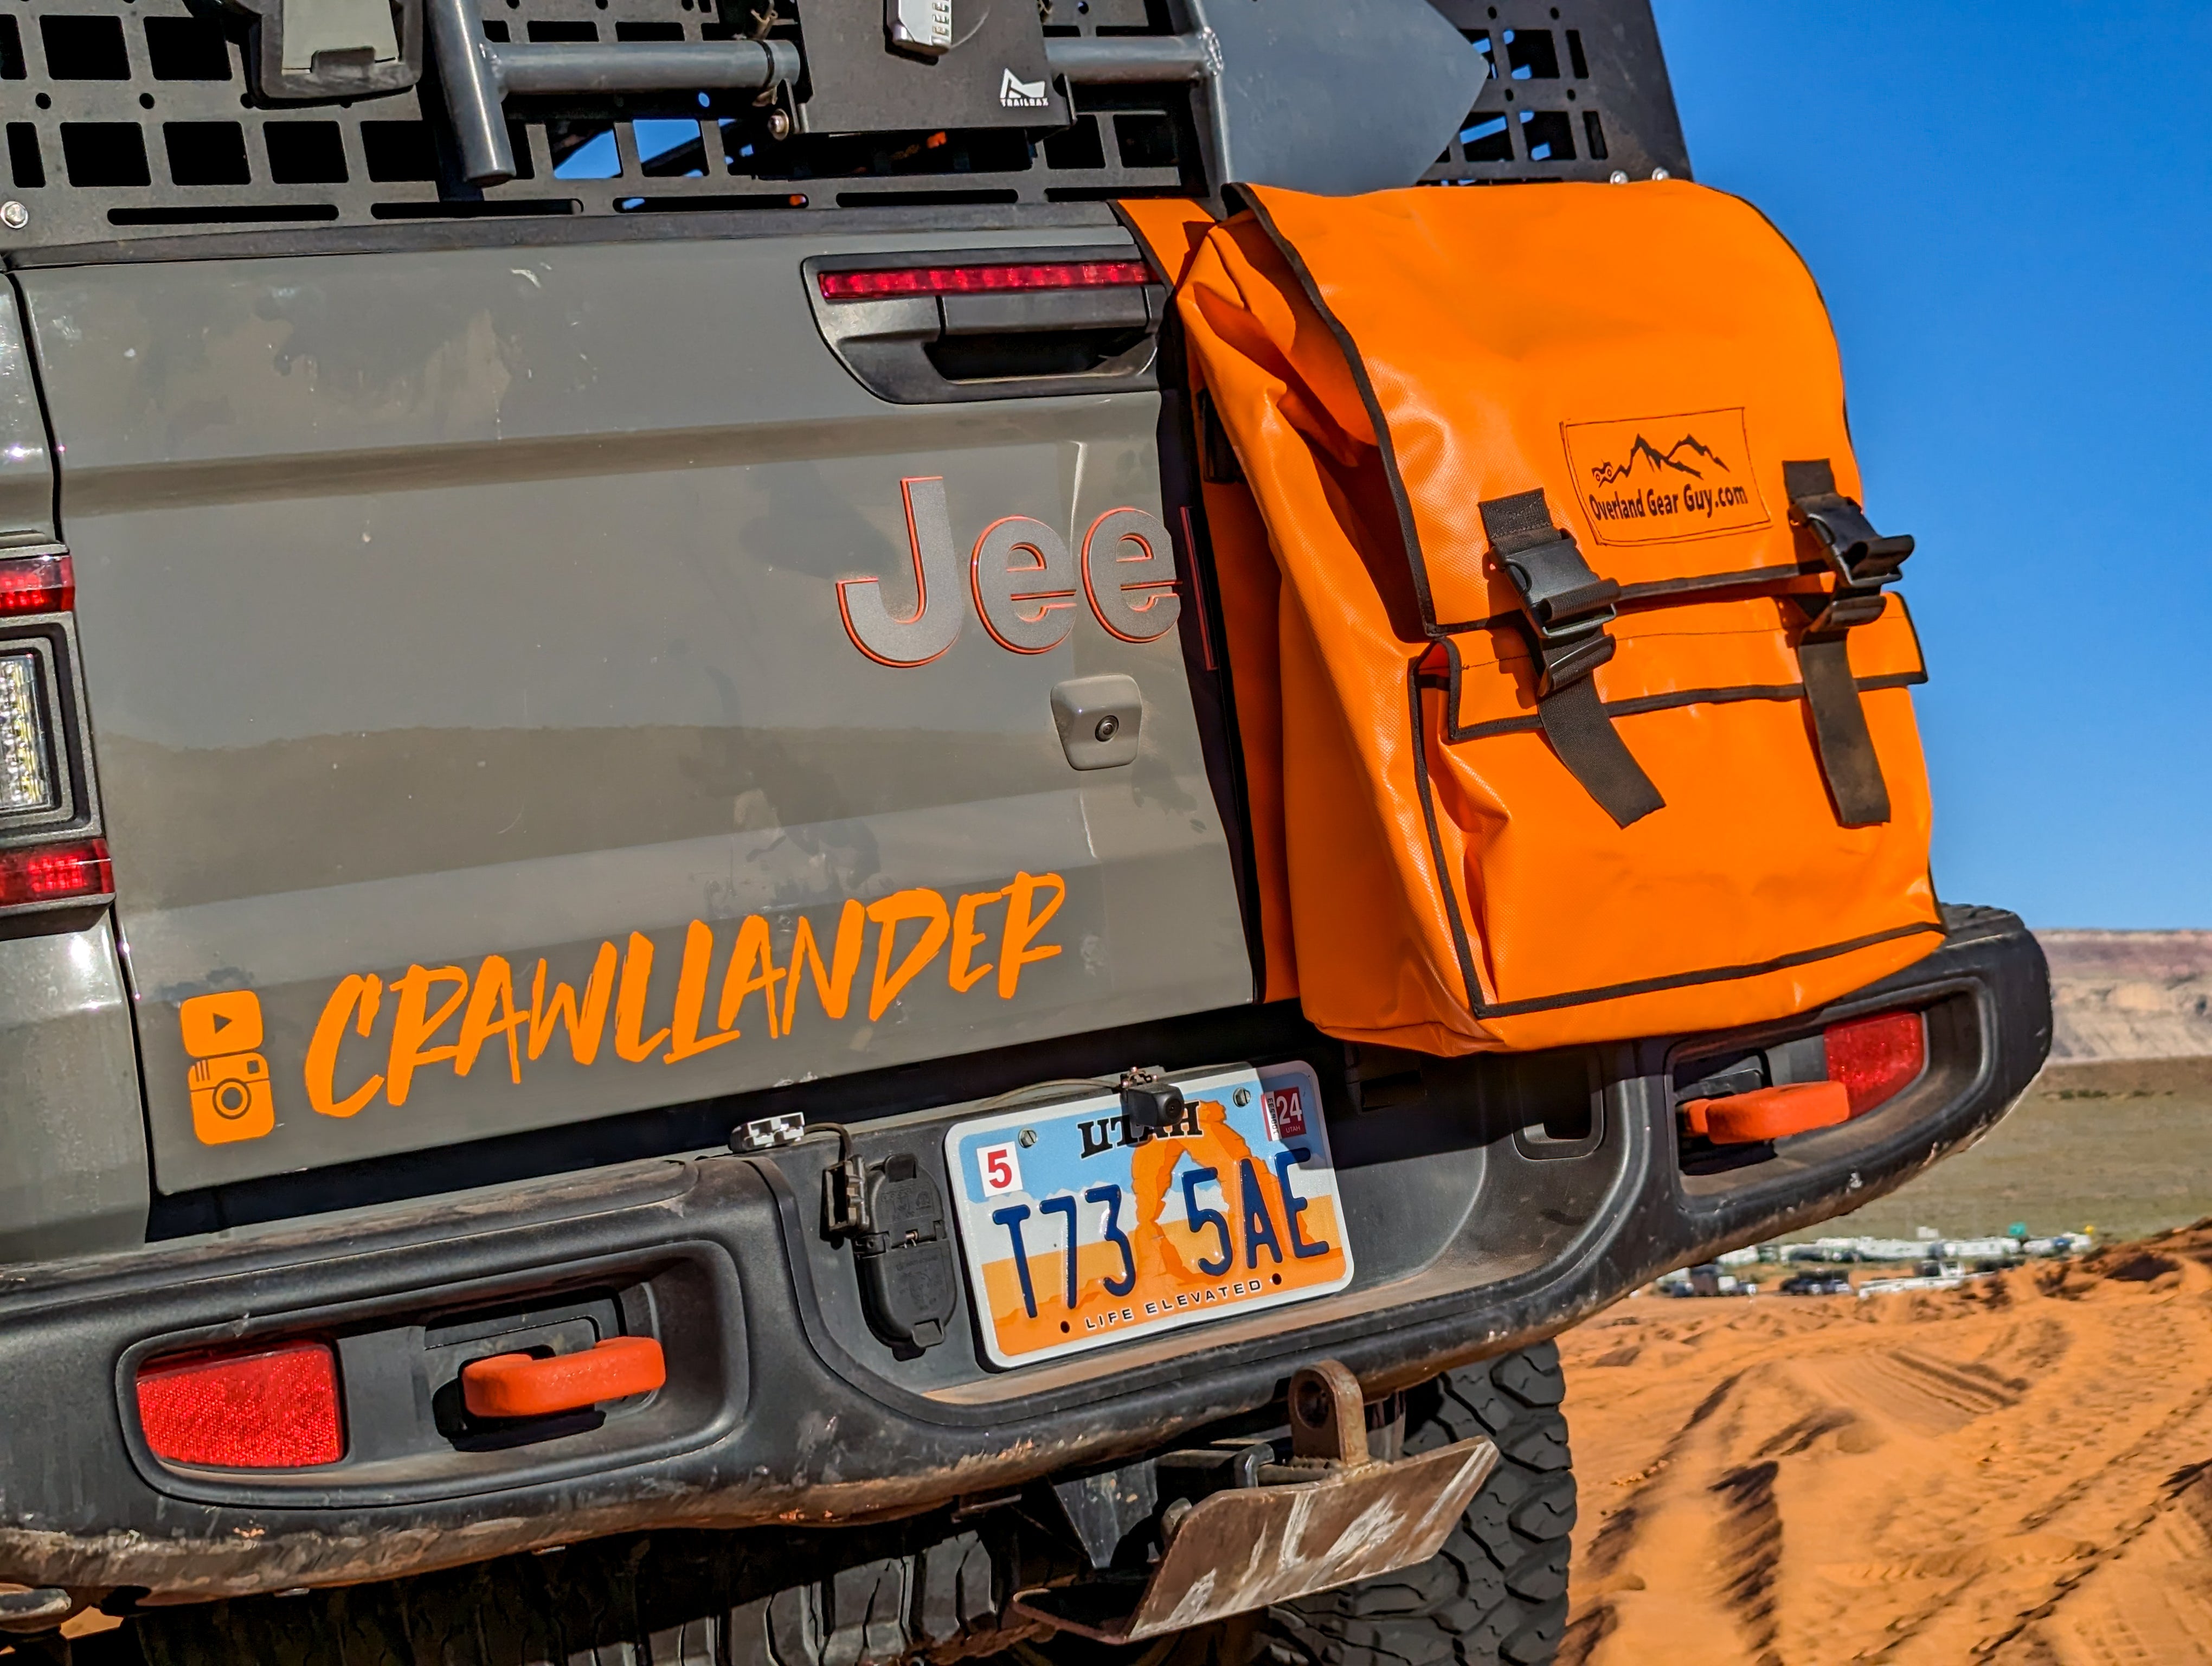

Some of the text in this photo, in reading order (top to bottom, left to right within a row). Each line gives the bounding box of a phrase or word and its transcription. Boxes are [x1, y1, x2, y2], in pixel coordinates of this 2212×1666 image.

[1589, 483, 1748, 521] Overland Gear Guy.com
[836, 476, 1218, 670] Jee
[305, 872, 1065, 1117] CRAWLLANDER
[1276, 1092, 1302, 1125] 24
[1285, 1125, 1301, 1133] UTAH
[987, 1150, 1012, 1188] 5
[1085, 1280, 1262, 1329] LIFE ELEVATED
